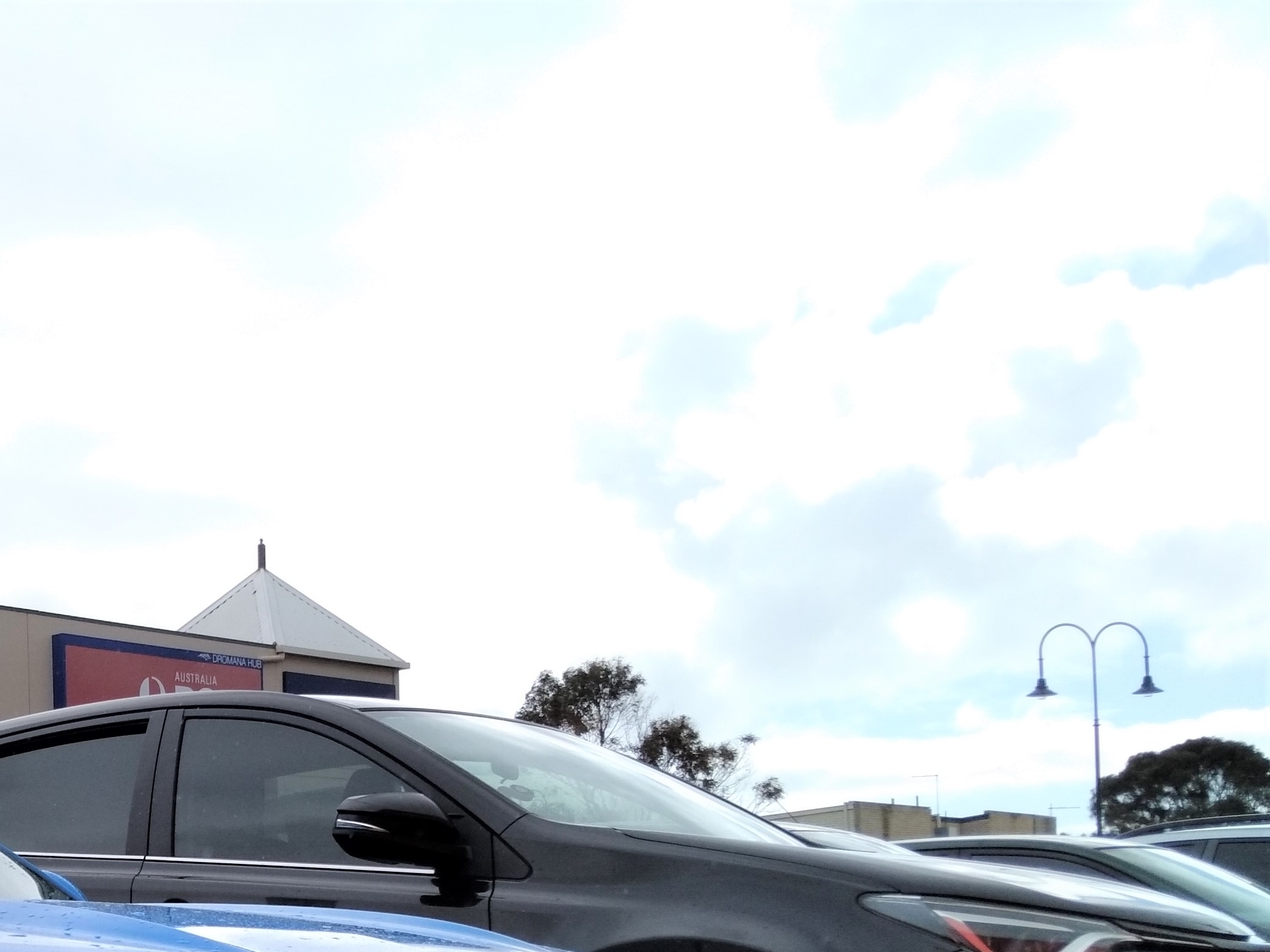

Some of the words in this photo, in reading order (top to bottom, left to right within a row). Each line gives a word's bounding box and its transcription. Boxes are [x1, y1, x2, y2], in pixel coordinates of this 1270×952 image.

[212, 654, 247, 667] DROMANA
[248, 659, 262, 669] HUB
[174, 671, 218, 686] AUSTRALIA
